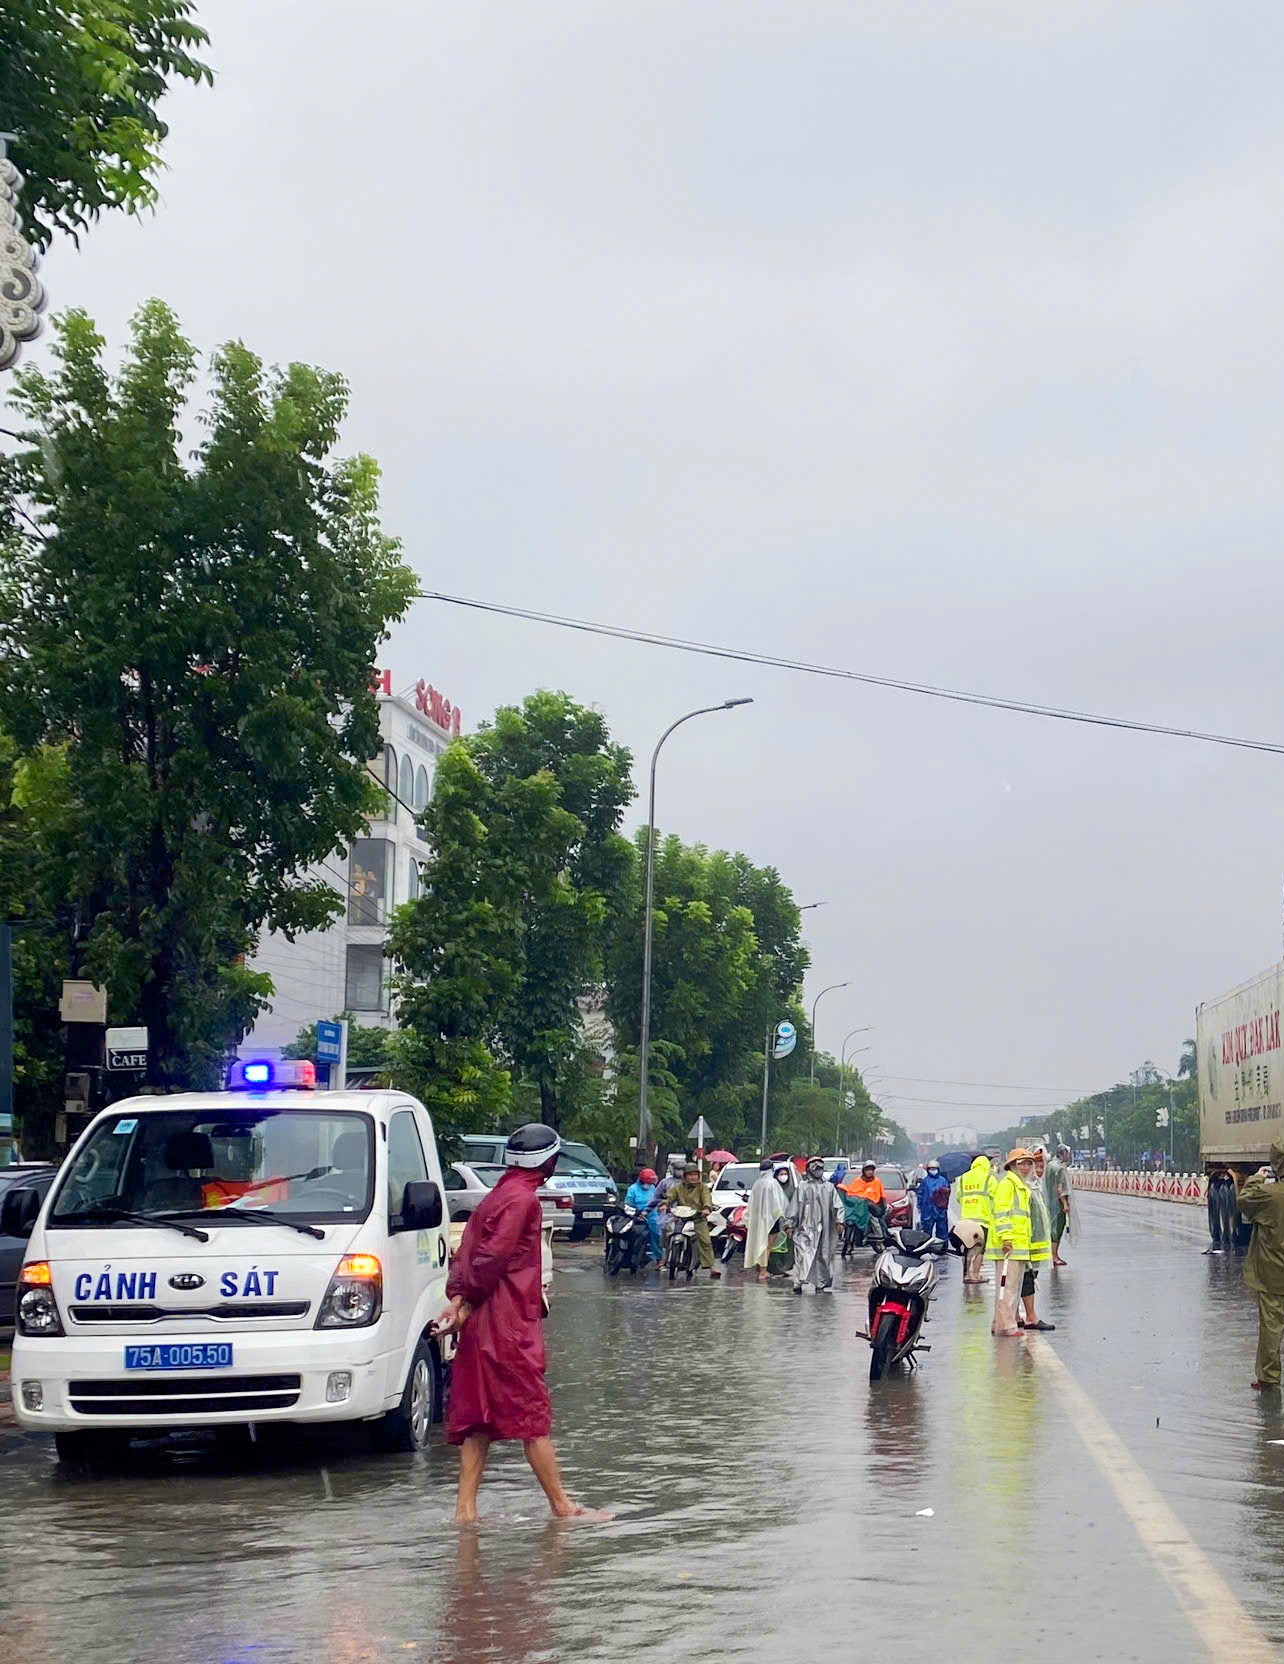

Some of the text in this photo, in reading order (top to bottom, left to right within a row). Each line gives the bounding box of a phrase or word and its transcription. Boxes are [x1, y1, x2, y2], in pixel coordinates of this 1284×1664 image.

[112, 1055, 146, 1067] CAFE
[74, 1264, 279, 1300] CẢNH SÁT
[173, 1275, 200, 1287] KIA
[128, 1344, 230, 1367] 75A-005.50
